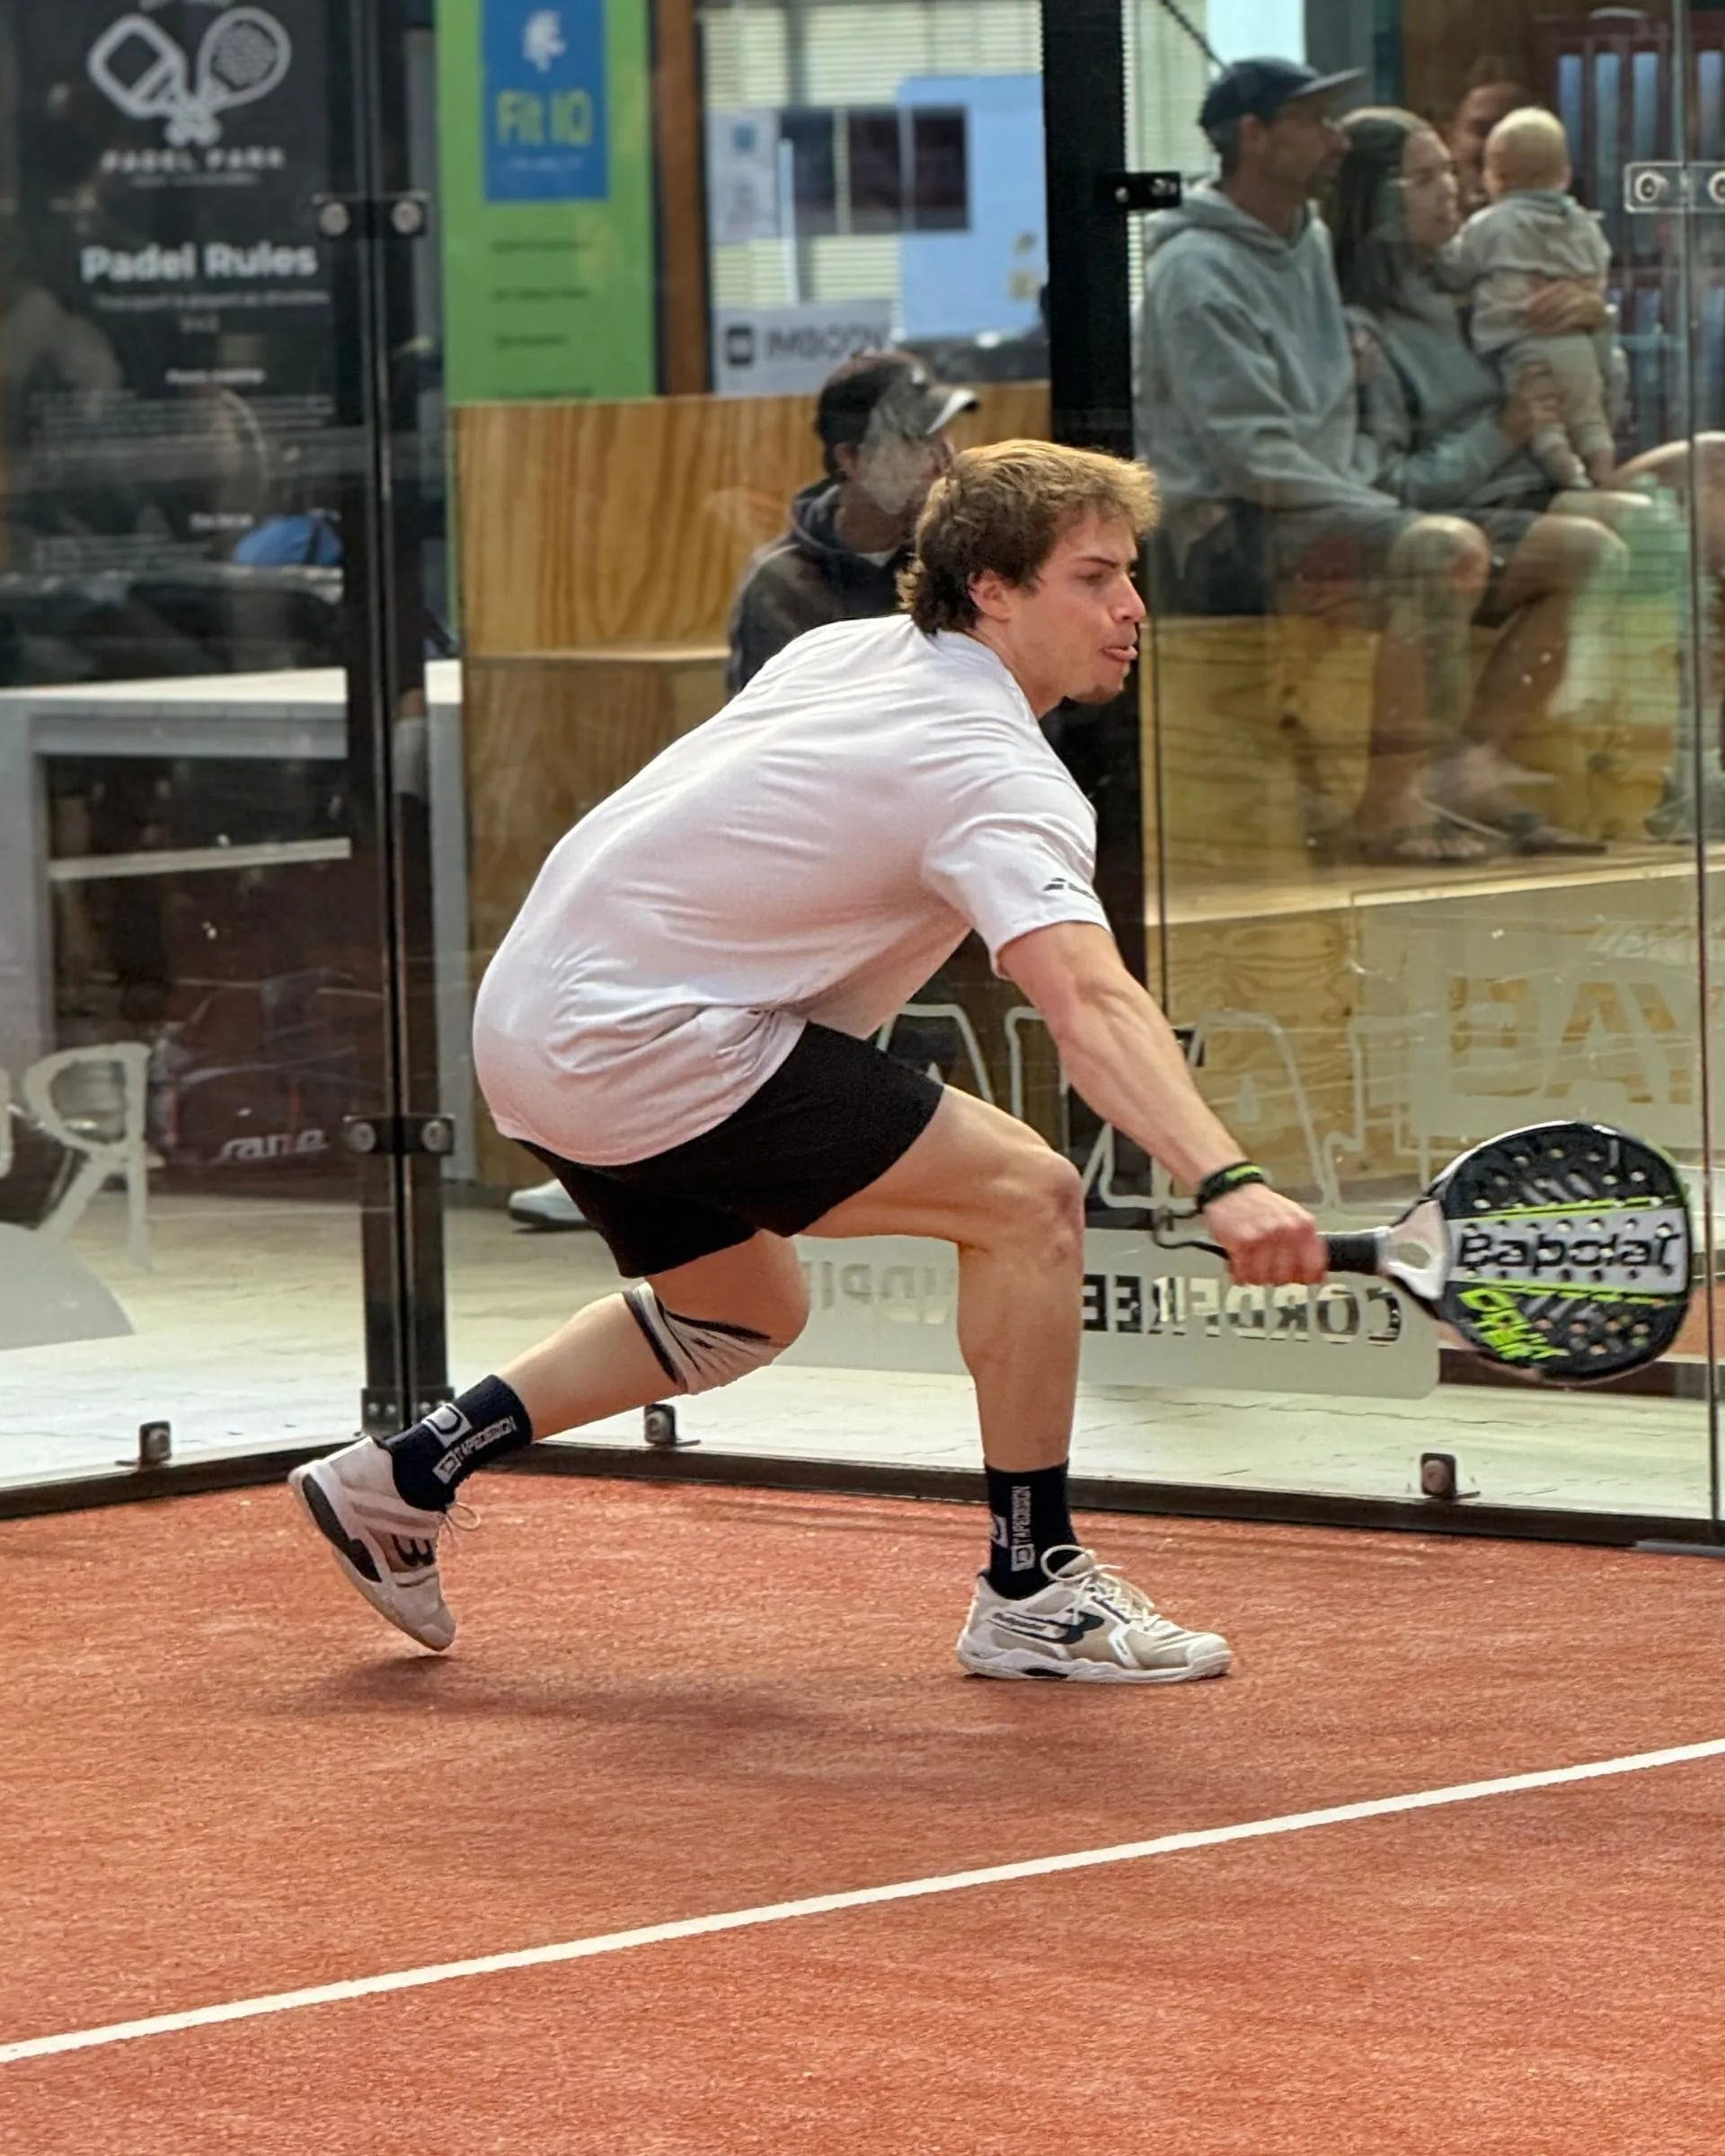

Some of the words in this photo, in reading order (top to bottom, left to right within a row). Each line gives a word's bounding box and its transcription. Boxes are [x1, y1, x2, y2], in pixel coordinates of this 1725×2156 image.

[497, 88, 545, 147] Fit
[80, 242, 197, 283] Padel
[203, 239, 318, 278] Rules
[1458, 1231, 1681, 1275] Babolat
